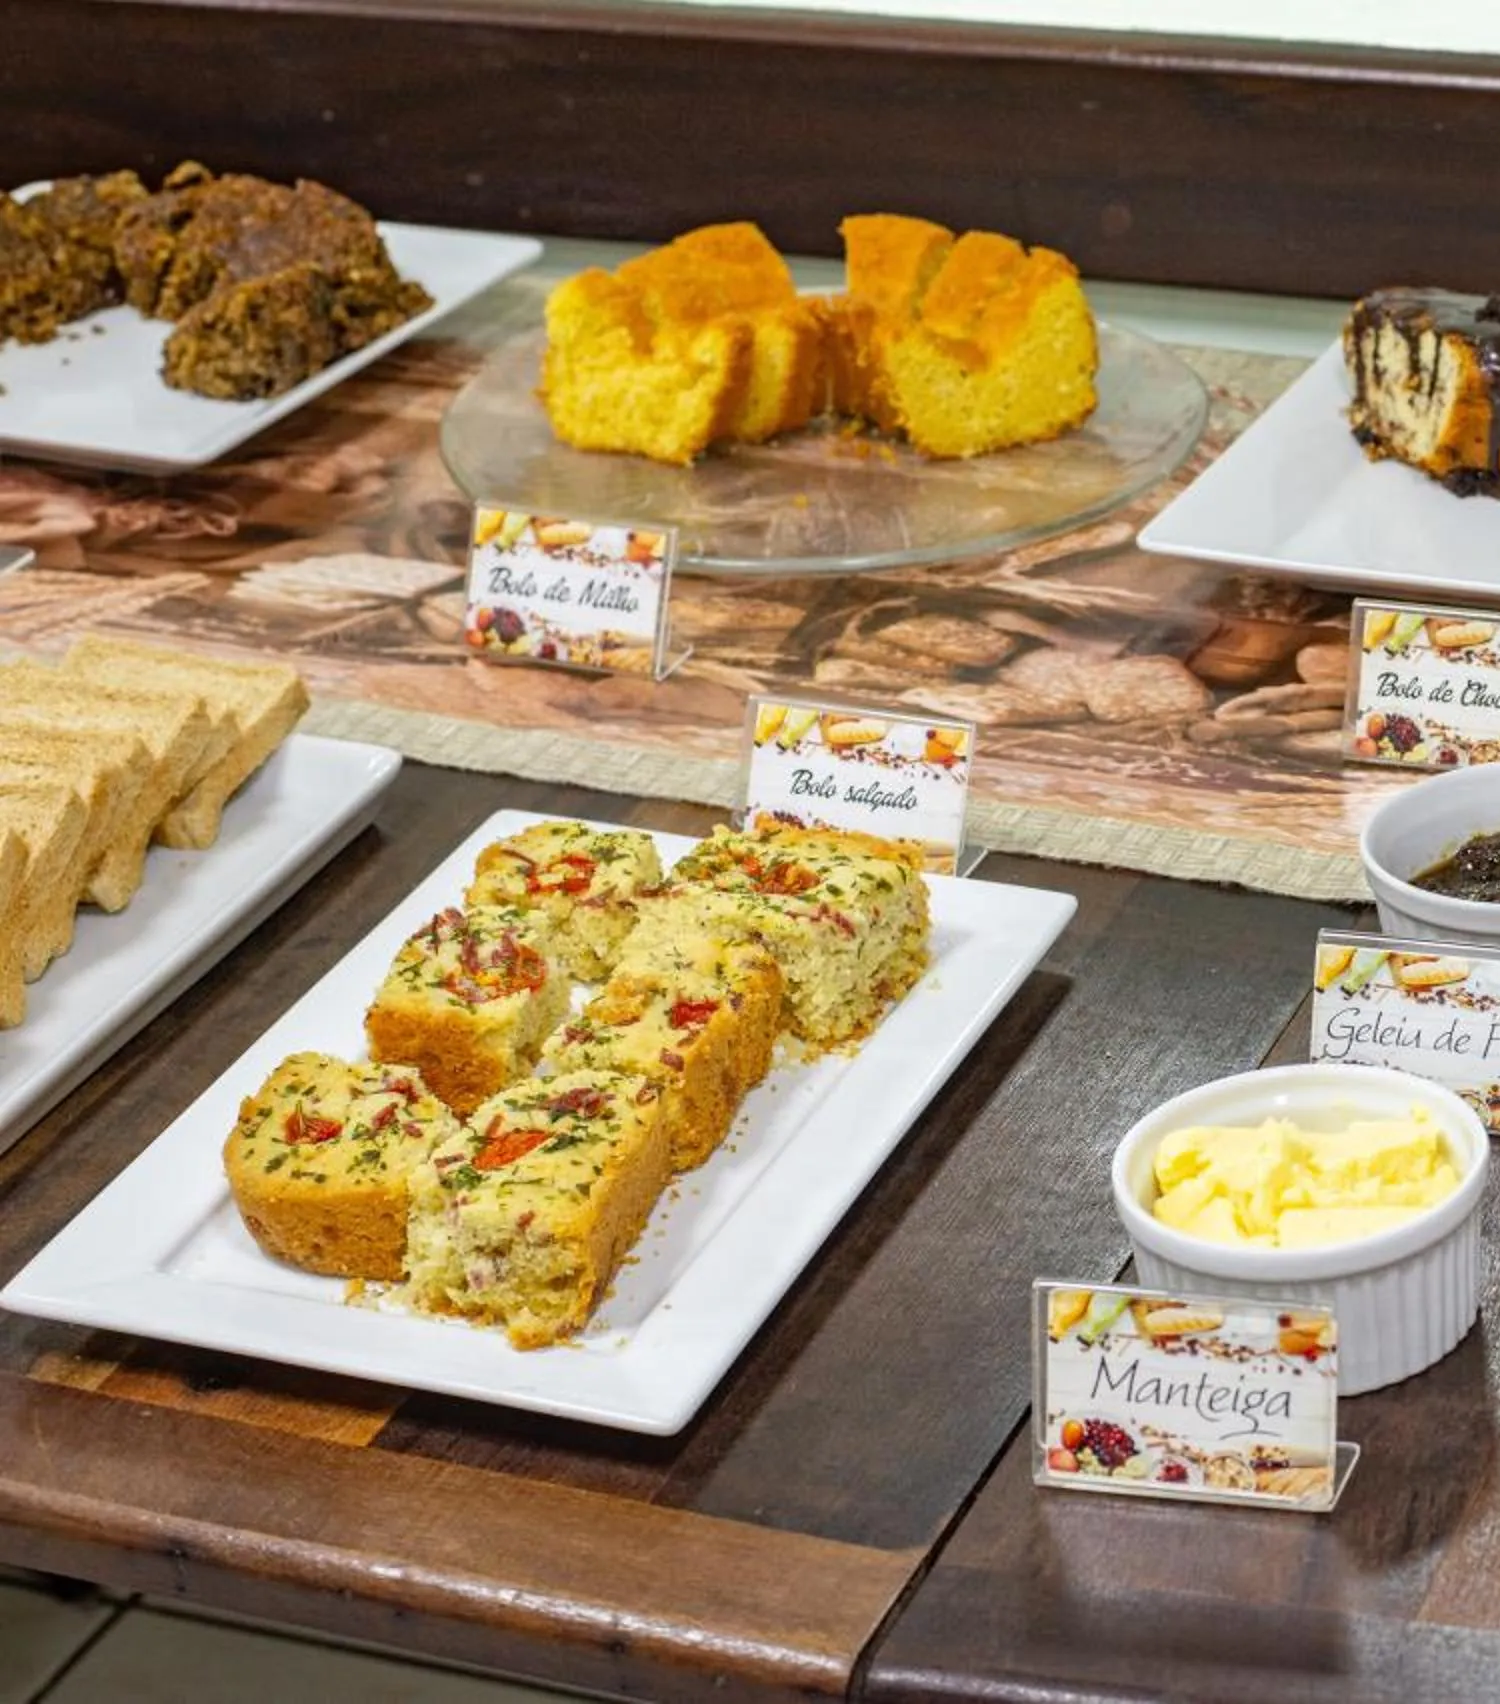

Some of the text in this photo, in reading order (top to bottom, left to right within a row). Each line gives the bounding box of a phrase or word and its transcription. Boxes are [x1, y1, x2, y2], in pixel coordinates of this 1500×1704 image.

[488, 567, 640, 614] Bolo de Milho
[1376, 672, 1424, 699] Bolo
[1427, 680, 1453, 703] de
[790, 769, 918, 812] Bolo salgado
[1325, 1008, 1423, 1059] Geleia
[1434, 1015, 1472, 1053] de
[1090, 1356, 1293, 1440] Manteiga
